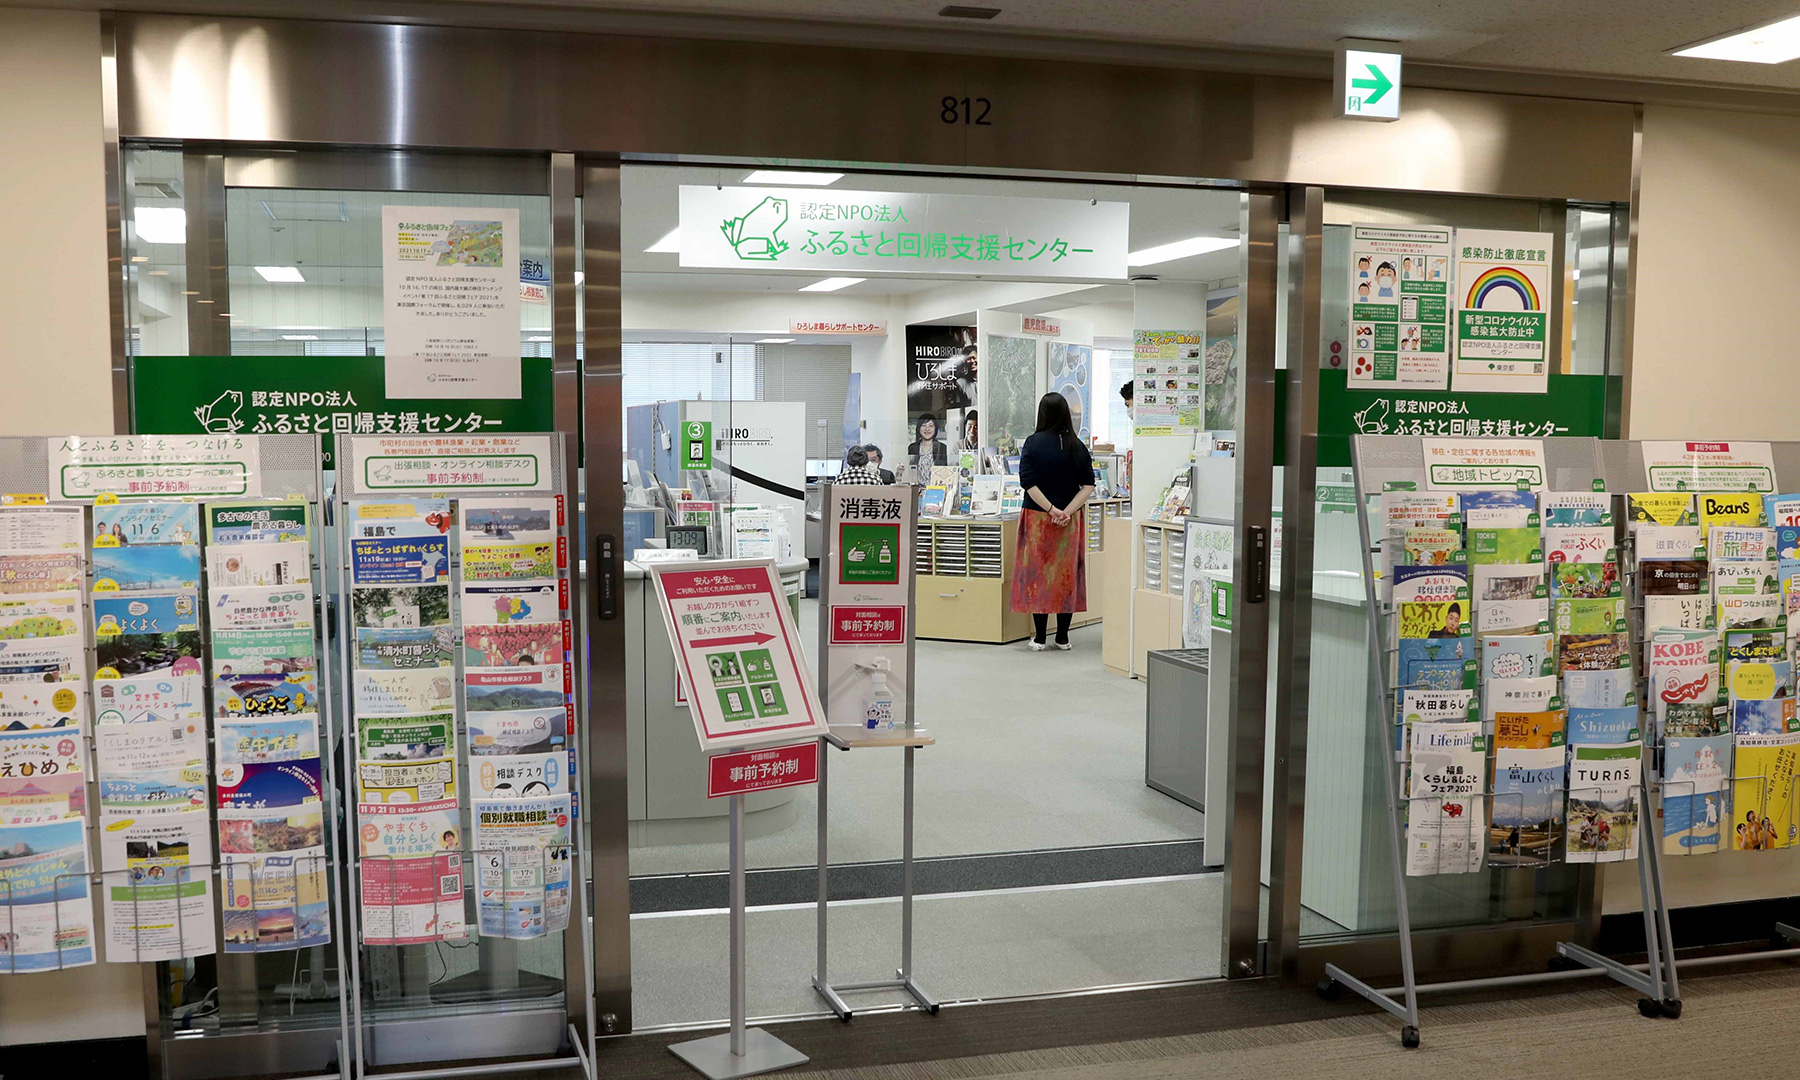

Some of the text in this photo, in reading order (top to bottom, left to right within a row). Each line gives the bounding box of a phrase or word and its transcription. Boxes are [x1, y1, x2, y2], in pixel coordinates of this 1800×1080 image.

[940, 96, 992, 126] 812
[799, 201, 909, 224] 認定NPO法人
[799, 228, 1094, 264] ふるさと回帰支援センター
[1462, 247, 1547, 262] 感染防止徹底宣言
[1464, 314, 1540, 326] 新型コロナウイルス
[796, 321, 880, 332] ひろしま暮らしサポートセンター
[1470, 326, 1535, 338] 感染拡大防止中
[1462, 341, 1542, 350] 認定NPO法人ふるさと回帰支援
[915, 362, 958, 381] ひろしま
[1496, 364, 1515, 372] 東京都
[251, 391, 357, 407] 認定NPO法人
[1394, 400, 1469, 414] 認定NPO法人
[251, 412, 502, 434] ふるさと回帰支援センター
[1393, 419, 1569, 436] ふるさと回帰支援センター
[59, 438, 243, 452] 人とふるさとを、つなげる
[1431, 448, 1536, 457] 移住・定住に関する各地域の情報を
[394, 460, 531, 470] 出張相談・オンライン相談デスク
[96, 468, 234, 478] ふるさと暮らしセミナーのご案内
[426, 473, 484, 484] 事前予約制
[1452, 469, 1537, 482] 地域トピックス
[128, 481, 190, 492] 事前予約制
[840, 498, 902, 520] 消毒液
[1706, 499, 1750, 516] Beans
[217, 511, 270, 522] 多古での生活
[1574, 509, 1586, 520] IT
[252, 521, 302, 530] 農ある暮らし
[1724, 531, 1764, 541] おかやま
[1576, 537, 1606, 551] ふくい
[693, 576, 735, 586] 安心・安全に
[676, 584, 757, 595] ご利用いただくためのお願いです
[686, 599, 760, 612] お越しの方から1組ずつ
[681, 611, 771, 626] 順番にご案内いたします
[695, 622, 766, 636] 並んでお待ちください
[840, 620, 894, 632] 事前予約制
[1653, 641, 1705, 658] KOBE
[245, 696, 288, 711] ひょうご
[1416, 700, 1465, 710] 秋田暮らし
[1498, 716, 1530, 724] にいがた
[1498, 724, 1530, 736] 暮らし
[1580, 720, 1632, 733] Shizuoka
[1430, 734, 1453, 747] Life
[750, 752, 780, 762] 対面相談は
[1, 759, 59, 778] えひめ
[496, 767, 542, 779] 相談デスク
[730, 758, 799, 782] 事前予約制
[1446, 766, 1464, 774] 福島
[480, 810, 548, 824] 個別就職相談
[383, 822, 428, 832] やまぐち
[384, 832, 438, 844] 自分らしく
